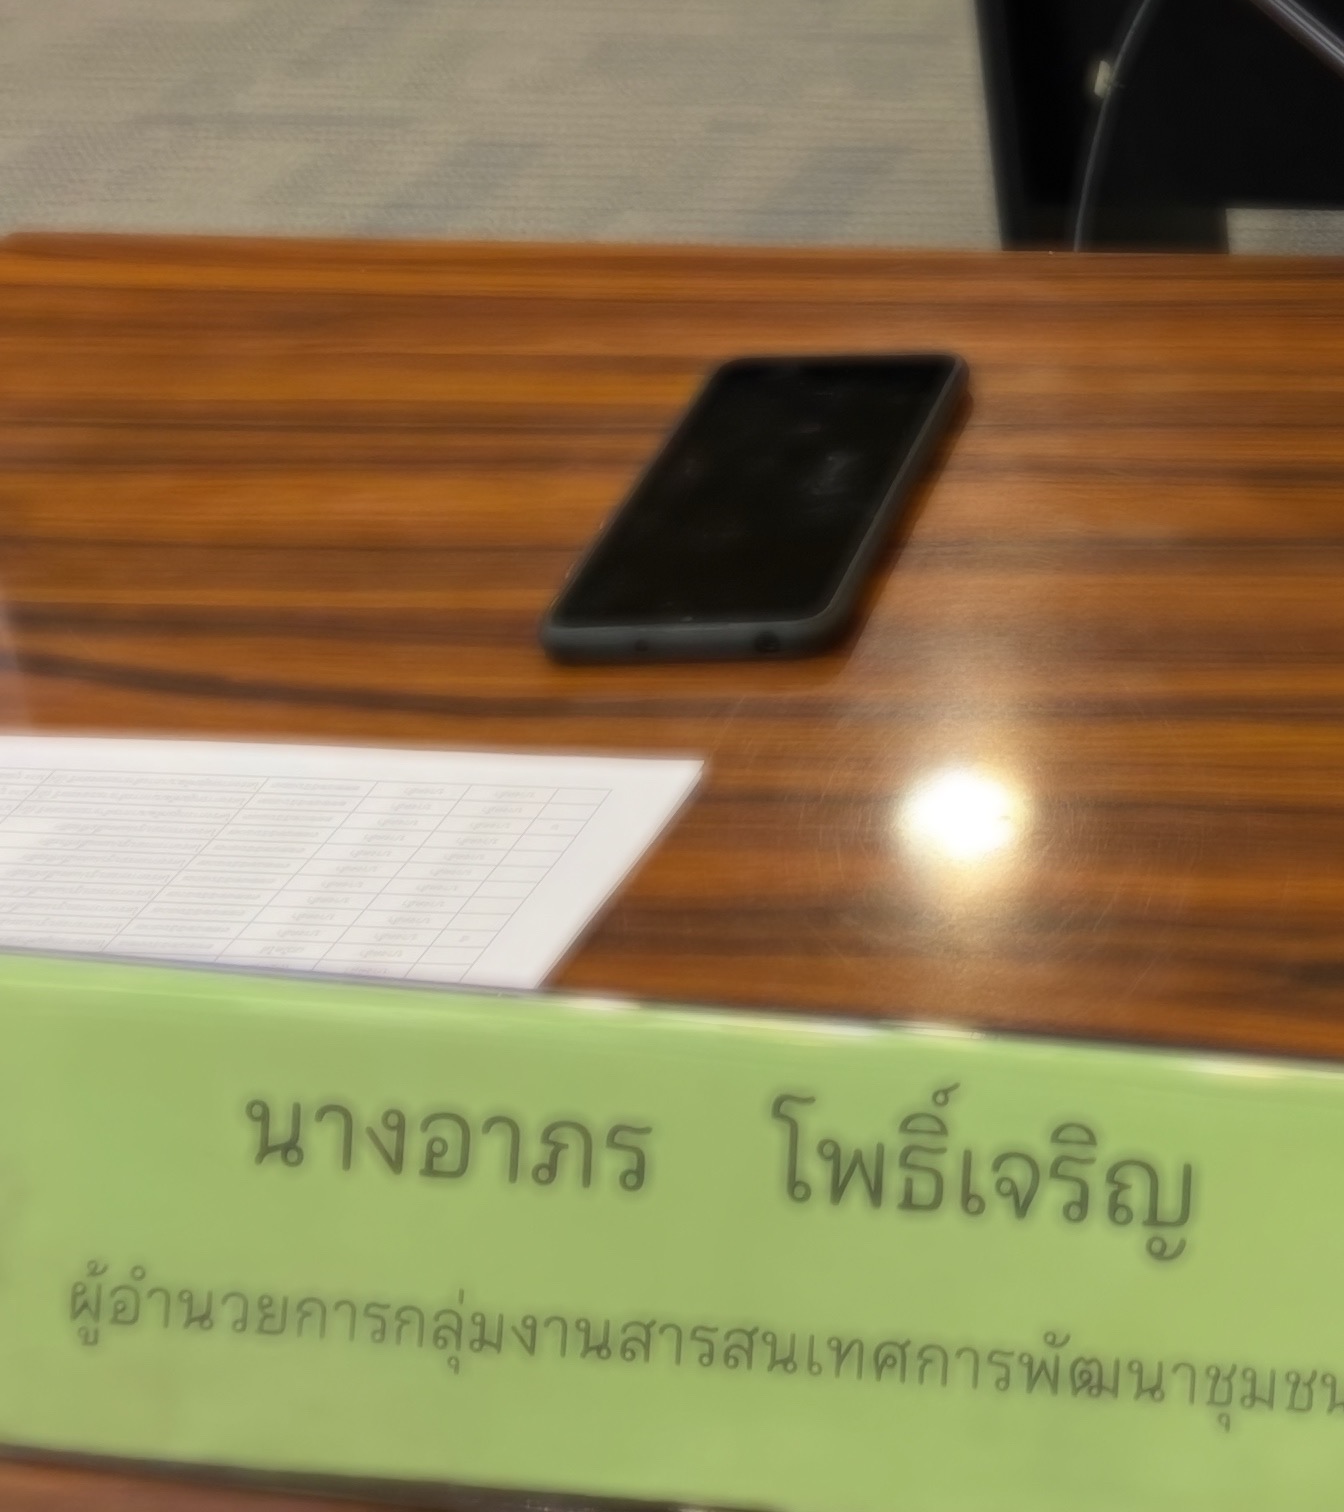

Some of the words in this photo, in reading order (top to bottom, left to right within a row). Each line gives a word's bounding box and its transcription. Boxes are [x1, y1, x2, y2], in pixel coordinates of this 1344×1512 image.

[247, 1098, 655, 1194] นางอาภร
[771, 1083, 1195, 1263] โพธิ์เจริญ
